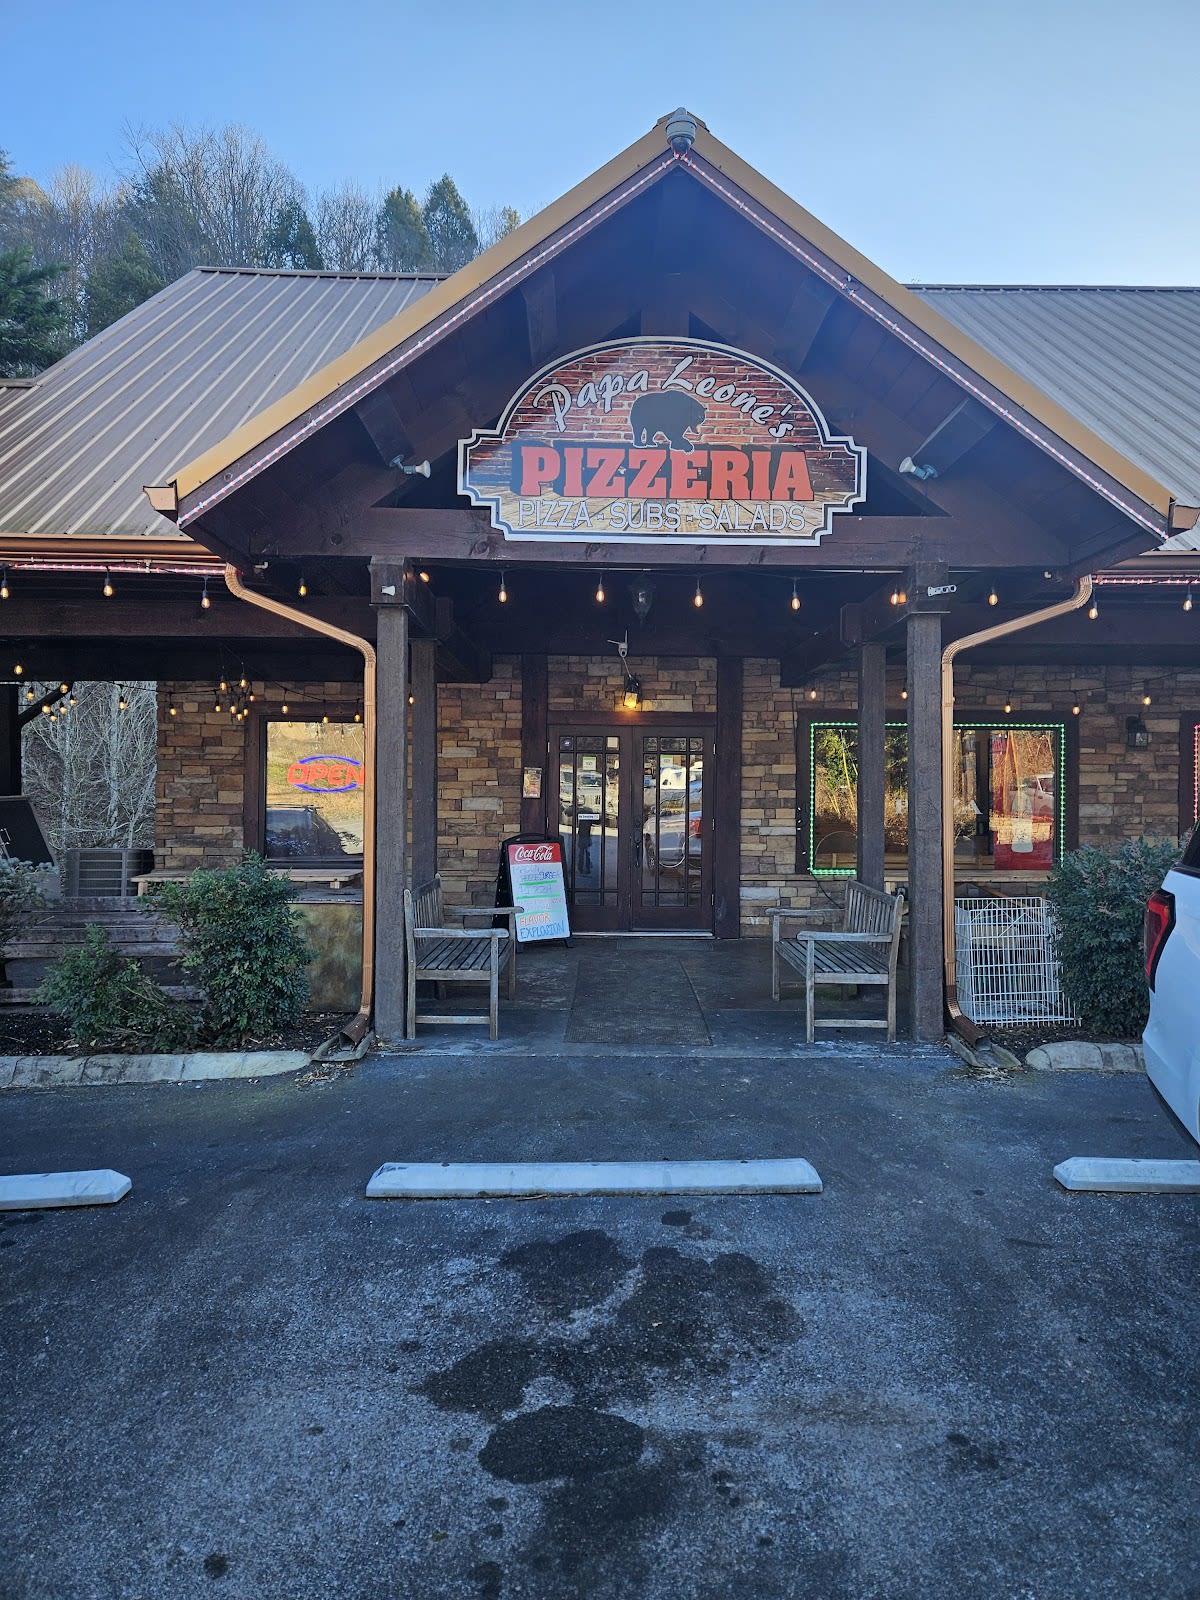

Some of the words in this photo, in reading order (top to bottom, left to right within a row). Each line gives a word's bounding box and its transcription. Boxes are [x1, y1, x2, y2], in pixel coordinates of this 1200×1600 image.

[533, 370, 649, 433] Papa
[661, 355, 794, 438] Leone's
[520, 446, 815, 500] PIZZERIA
[518, 500, 593, 529] PIZZA
[609, 502, 682, 530] SUBS
[698, 503, 806, 531] SALADS
[287, 763, 365, 785] OPEN
[515, 845, 554, 862] Coca-Cola
[520, 920, 565, 939] EXPLOSION
